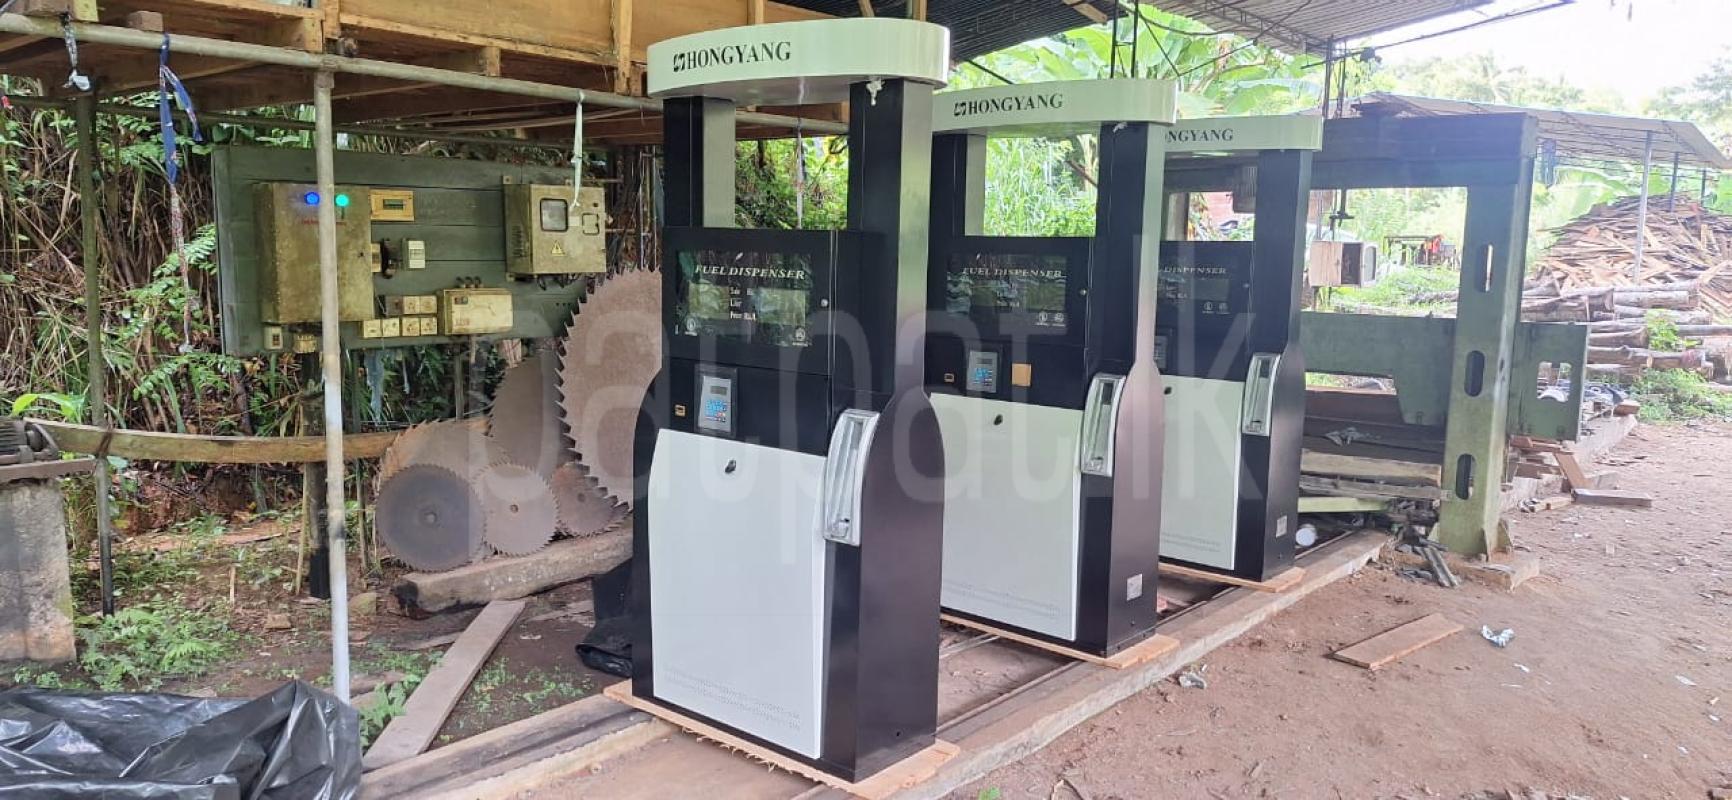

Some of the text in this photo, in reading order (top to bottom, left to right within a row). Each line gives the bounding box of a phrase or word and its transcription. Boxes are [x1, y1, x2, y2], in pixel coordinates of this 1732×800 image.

[687, 41, 791, 70] HONGYANG
[968, 92, 1063, 116] HONGYANG
[695, 264, 806, 280] FUEL DISPENSER
